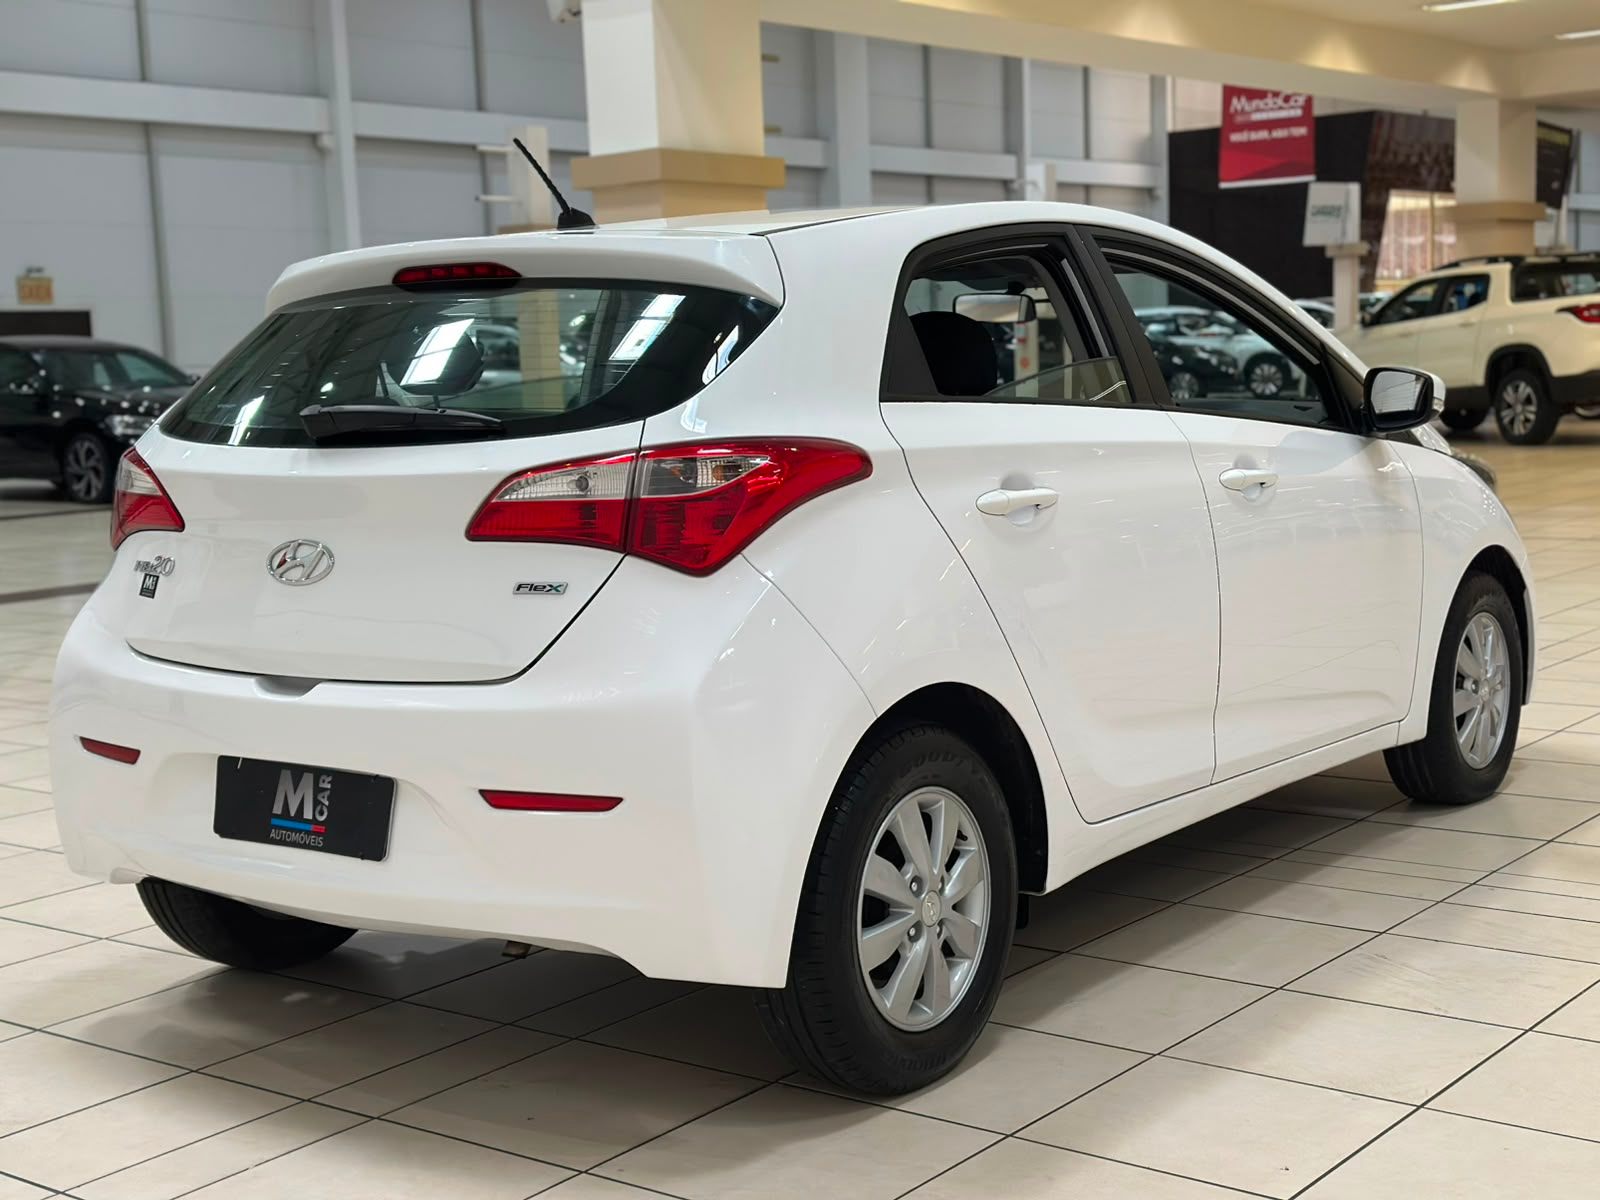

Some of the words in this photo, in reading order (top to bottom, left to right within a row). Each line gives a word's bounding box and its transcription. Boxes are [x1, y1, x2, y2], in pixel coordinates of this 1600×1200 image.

[515, 583, 565, 593] Flex
[272, 769, 314, 819] M
[314, 774, 333, 822] CAR
[270, 829, 323, 846] AUTOMÓVEIS
